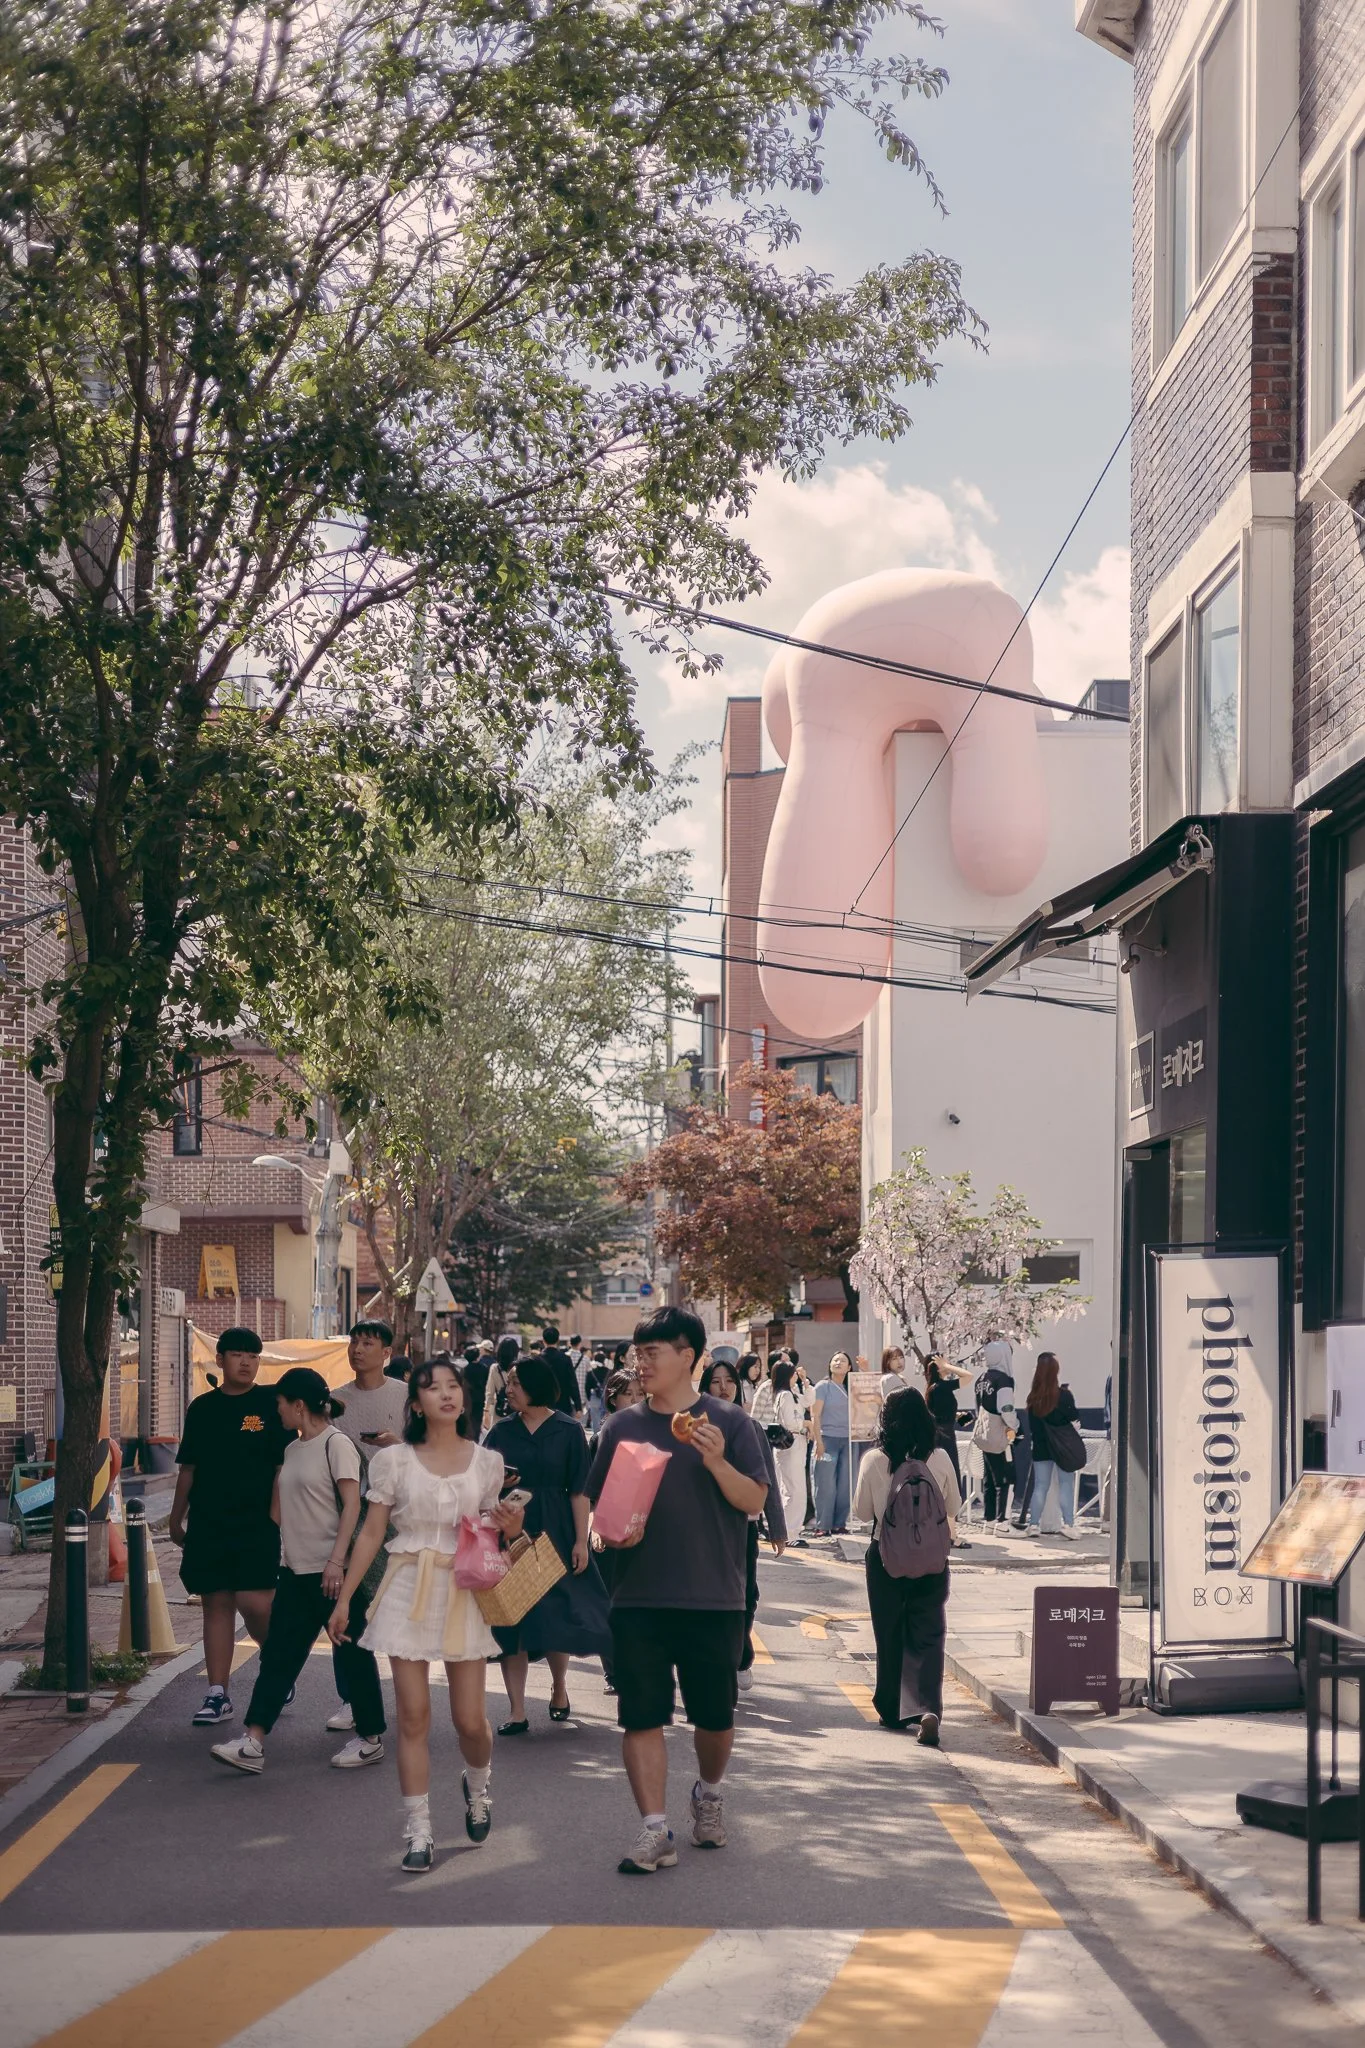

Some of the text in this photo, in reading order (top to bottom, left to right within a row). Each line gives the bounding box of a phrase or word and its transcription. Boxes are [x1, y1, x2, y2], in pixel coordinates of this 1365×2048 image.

[1186, 1293, 1254, 1576] photoism
[1193, 1585, 1253, 1608] BOX
[1048, 1607, 1107, 1624] 로매지크
